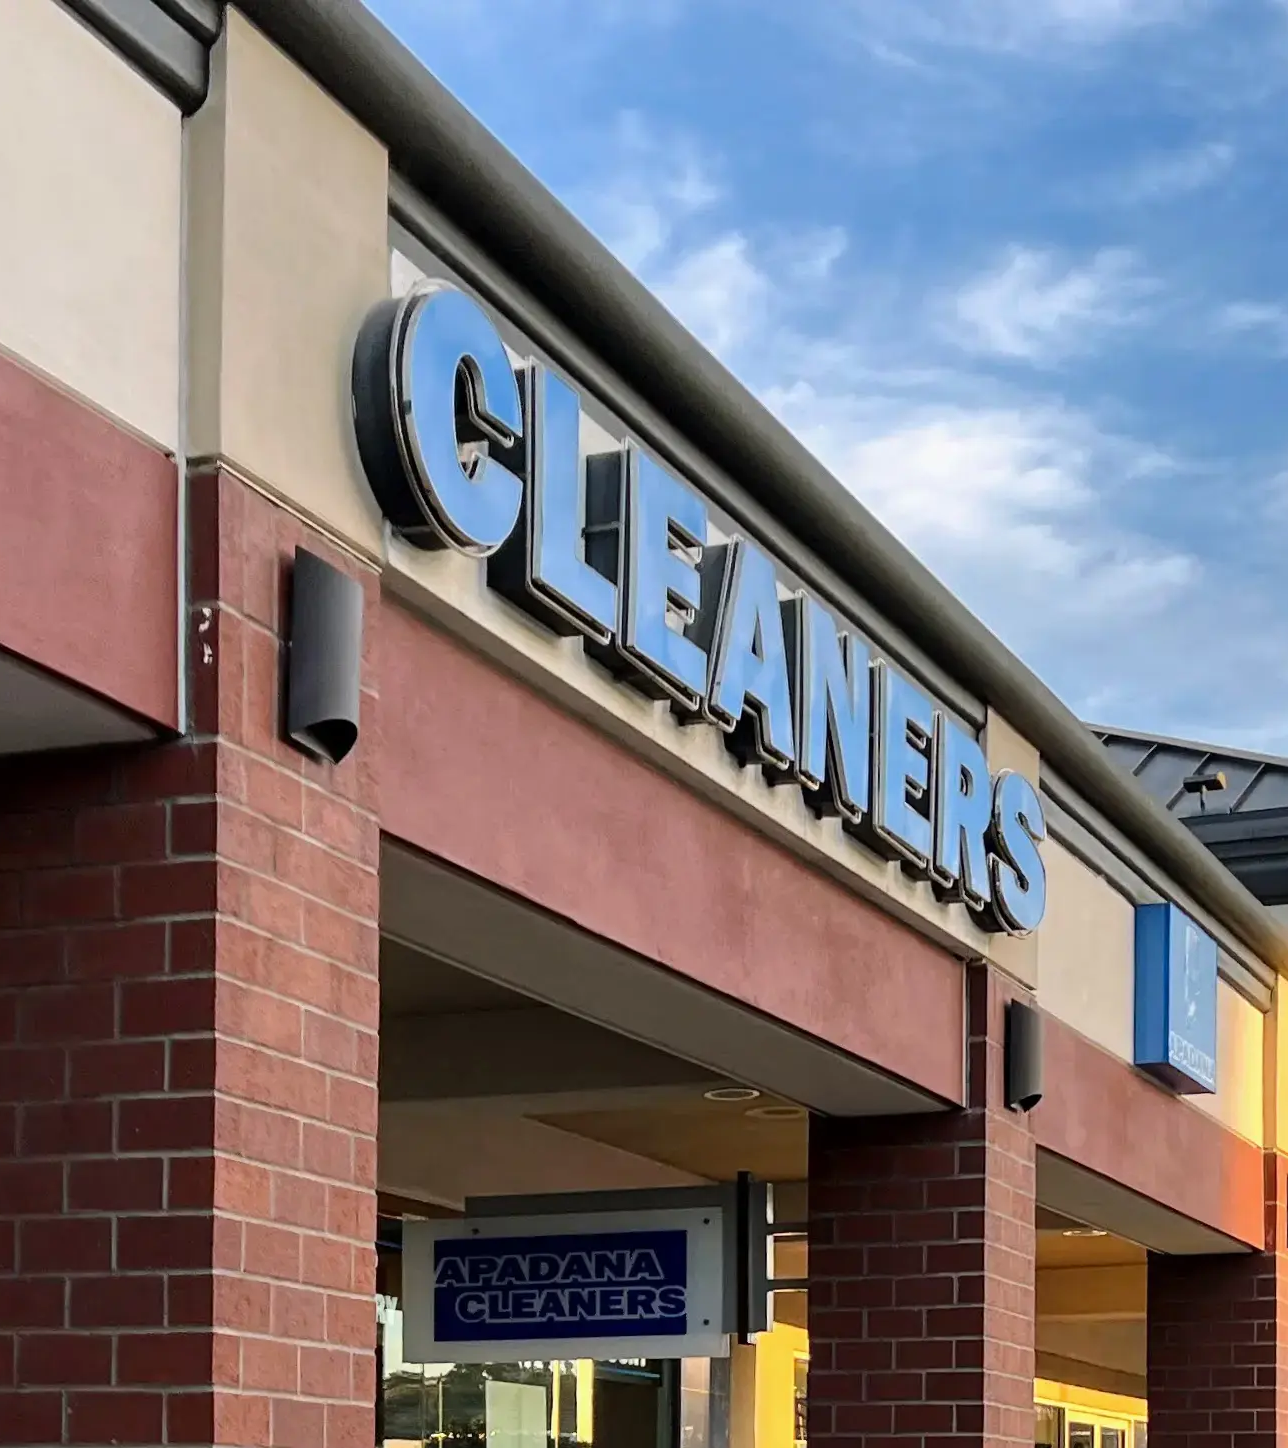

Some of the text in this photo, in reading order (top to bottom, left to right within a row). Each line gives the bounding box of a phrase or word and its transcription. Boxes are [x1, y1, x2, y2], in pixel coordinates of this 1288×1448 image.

[378, 276, 1047, 939] CLEANERS
[434, 1249, 665, 1289] APADANA
[455, 1285, 687, 1323] CLEANERS
